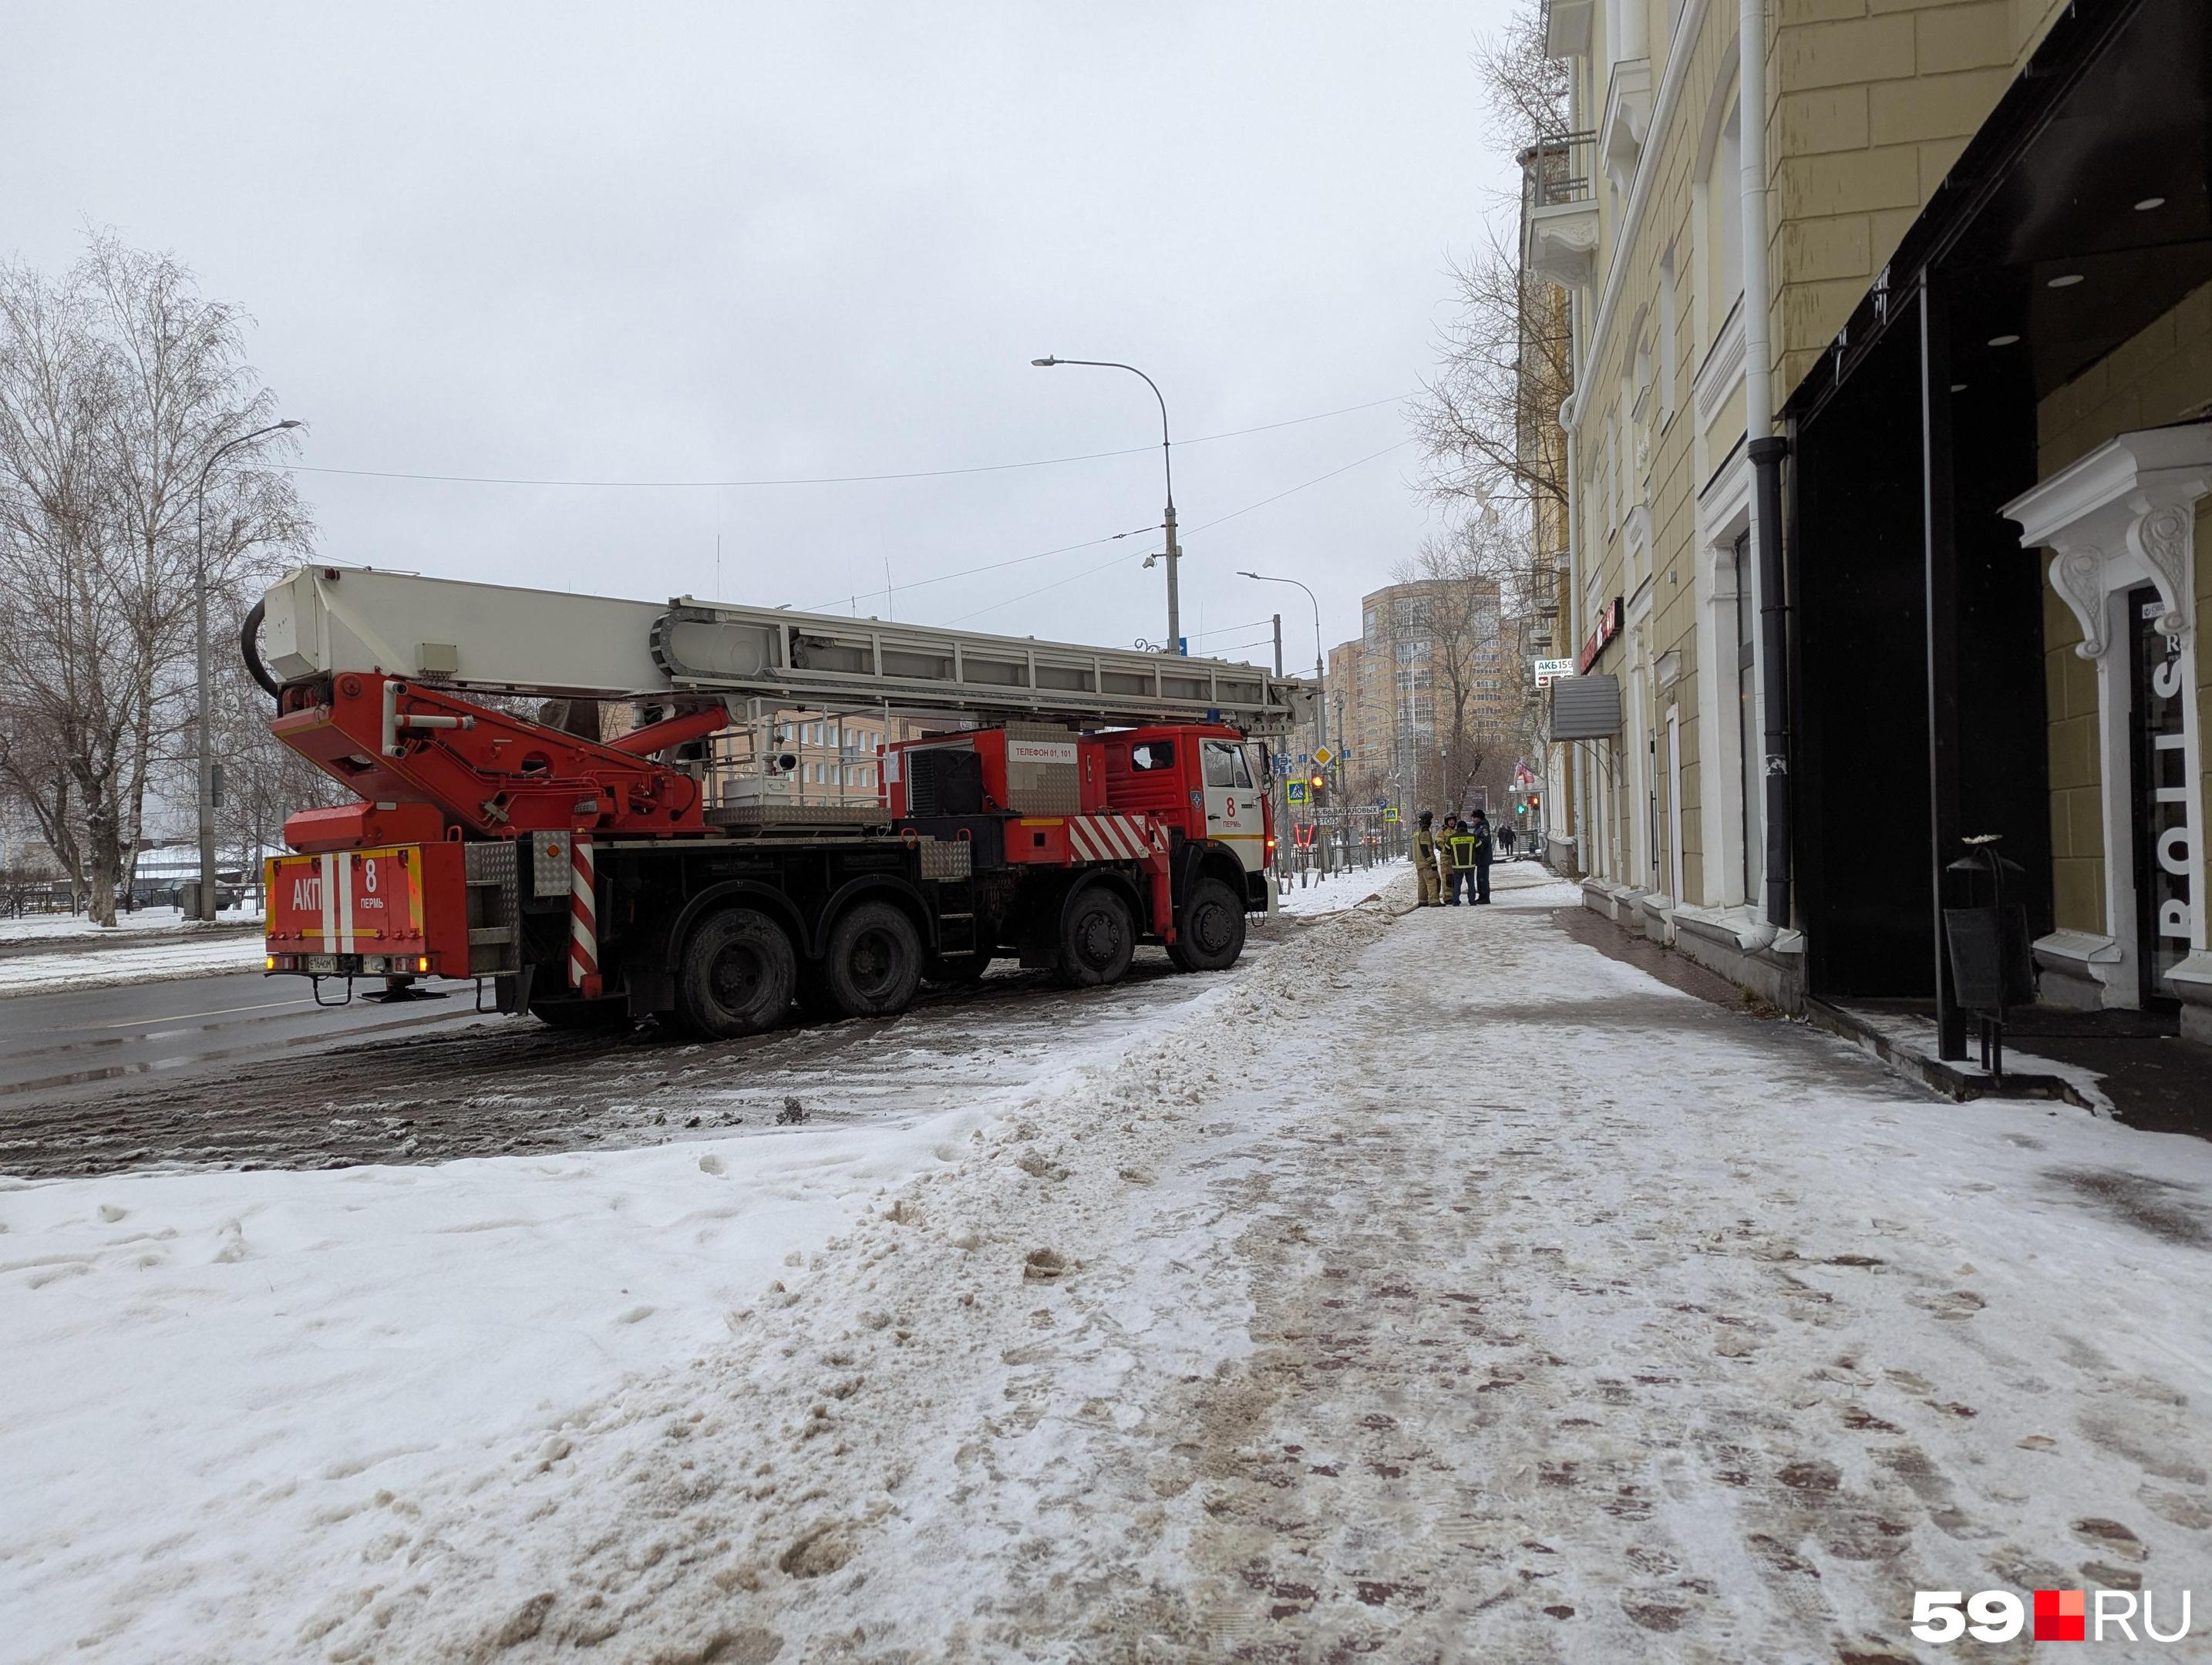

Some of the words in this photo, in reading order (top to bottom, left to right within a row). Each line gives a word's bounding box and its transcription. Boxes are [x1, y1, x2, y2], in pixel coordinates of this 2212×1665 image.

[1016, 748, 1049, 756] ТЕЛЕФОН
[1050, 749, 1059, 758] 01,
[1226, 796, 1236, 818] 8
[365, 859, 377, 893] 8
[292, 878, 322, 910] АКП
[360, 897, 384, 909] ПЕРМЬ
